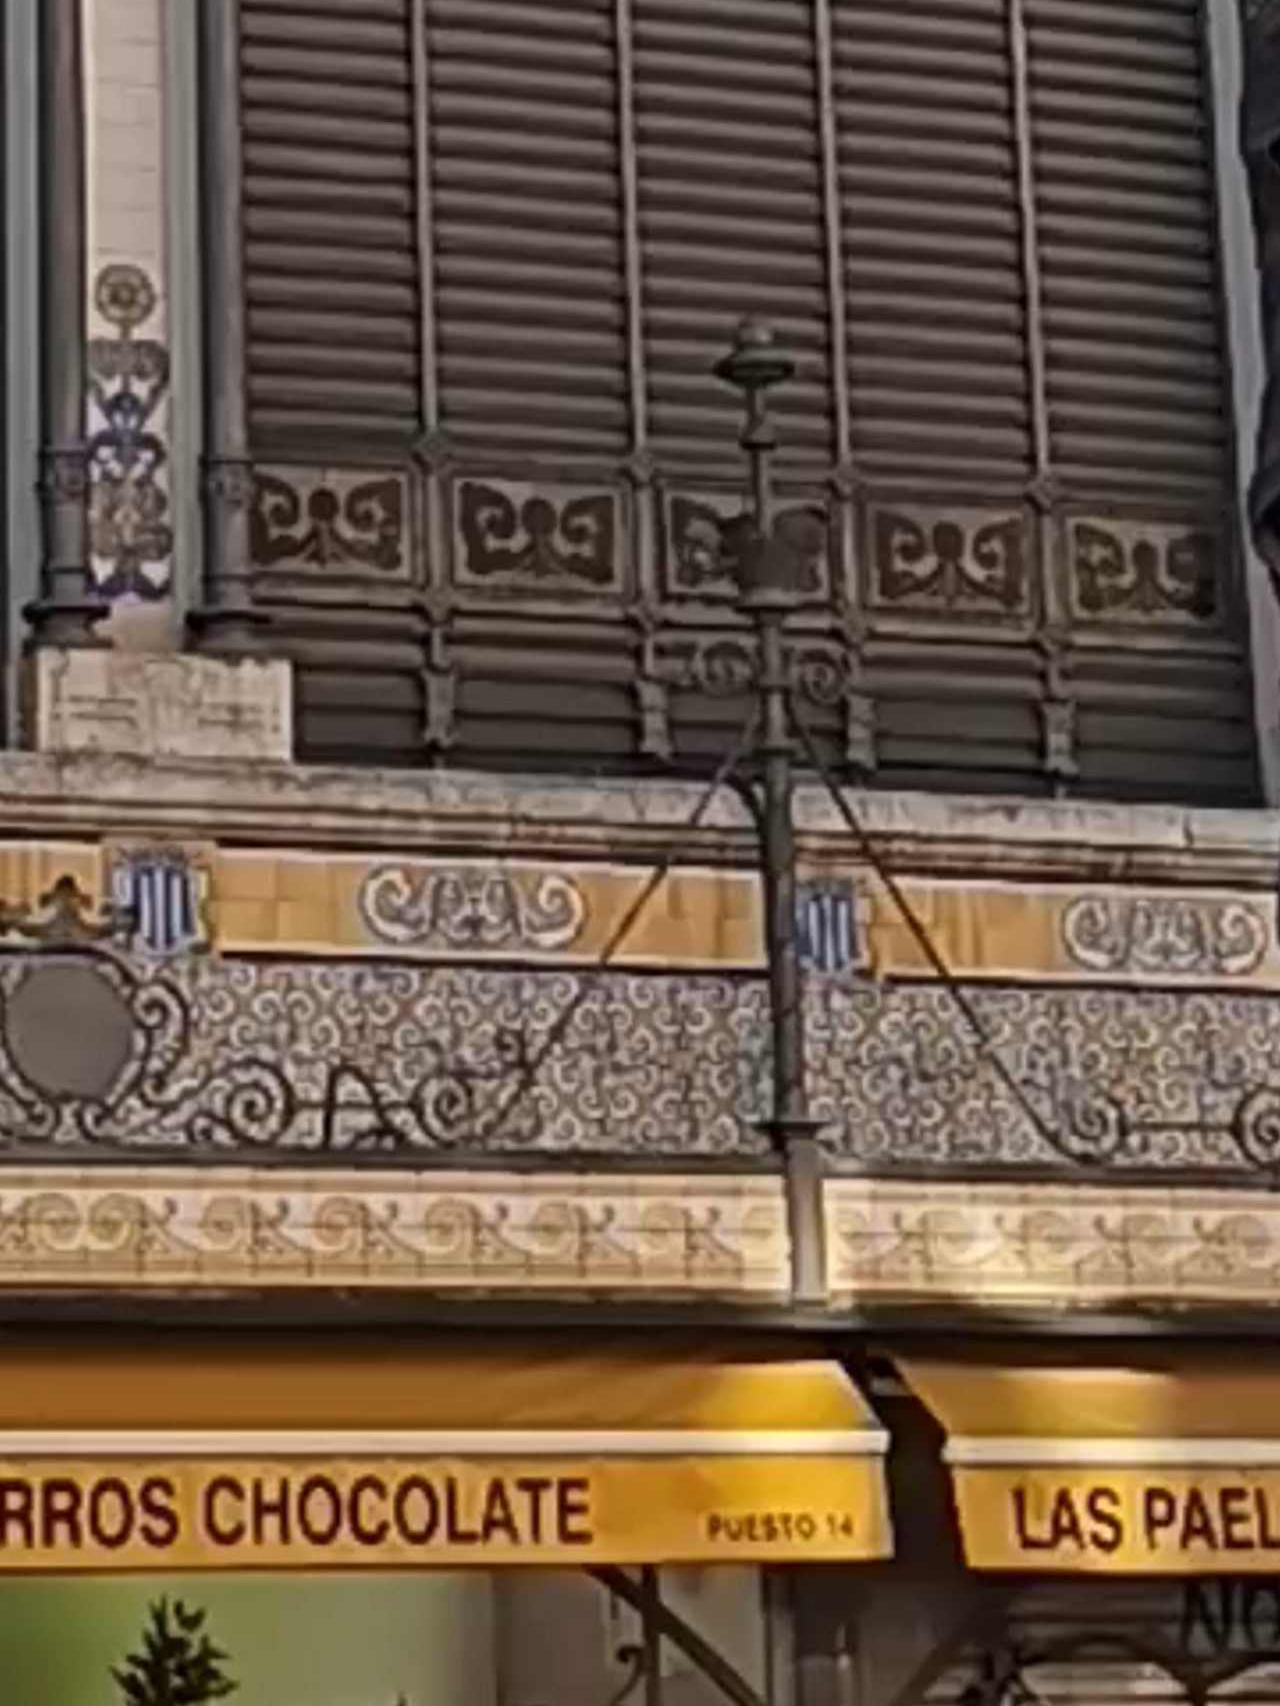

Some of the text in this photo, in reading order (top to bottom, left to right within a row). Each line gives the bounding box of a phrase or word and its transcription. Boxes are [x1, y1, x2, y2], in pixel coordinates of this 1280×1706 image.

[202, 1473, 595, 1546] CHOCOLATE
[706, 1511, 817, 1543] PUESTO
[825, 1511, 854, 1537] 14
[1013, 1486, 1124, 1552] LAS
